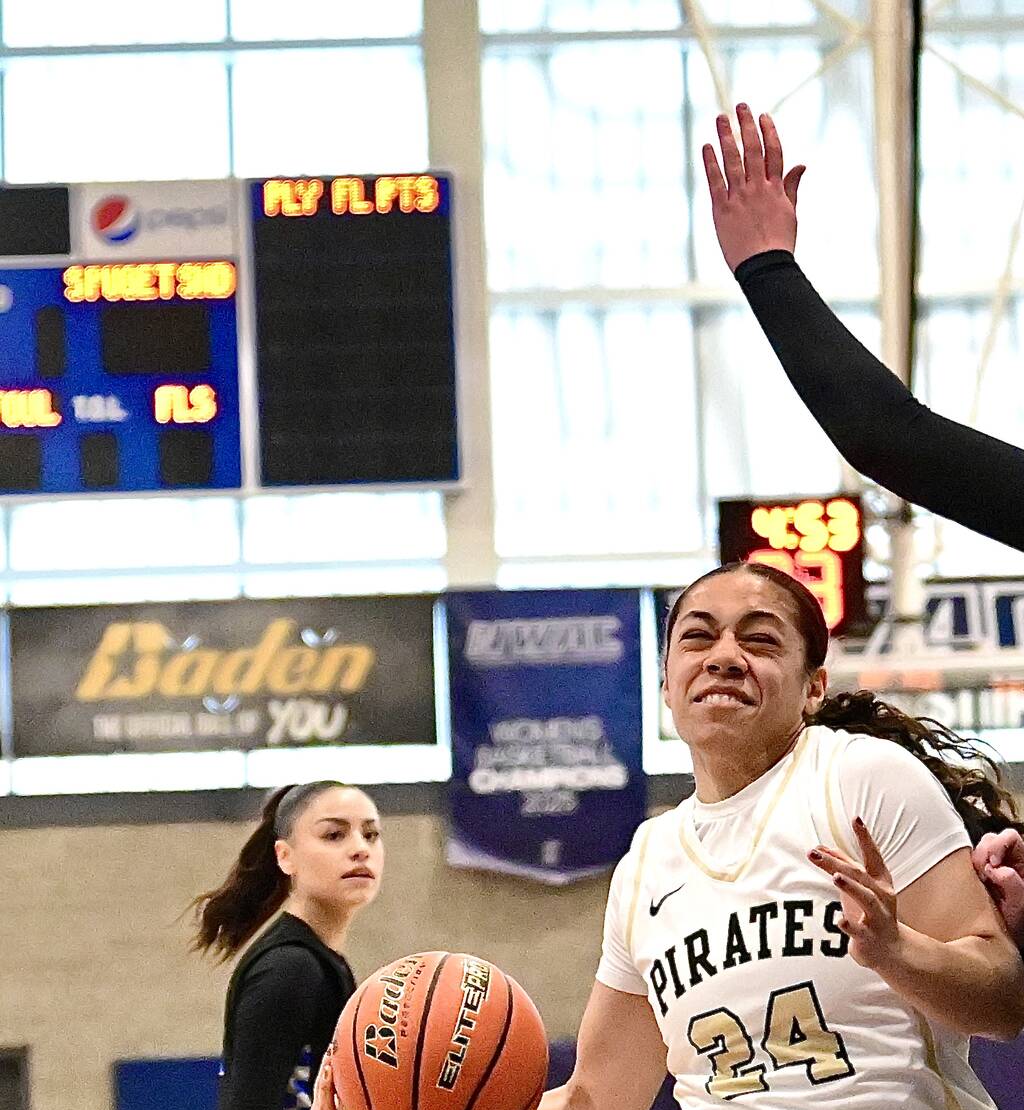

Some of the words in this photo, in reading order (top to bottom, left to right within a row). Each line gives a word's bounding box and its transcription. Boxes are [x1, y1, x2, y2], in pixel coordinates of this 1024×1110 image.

[375, 175, 440, 214] PTS
[752, 499, 860, 552] 4:53
[75, 617, 376, 701] Baden
[266, 699, 348, 743] YOU
[648, 900, 851, 1018] PIRATES
[436, 986, 485, 1093] ELITE
[686, 979, 857, 1101] 24
